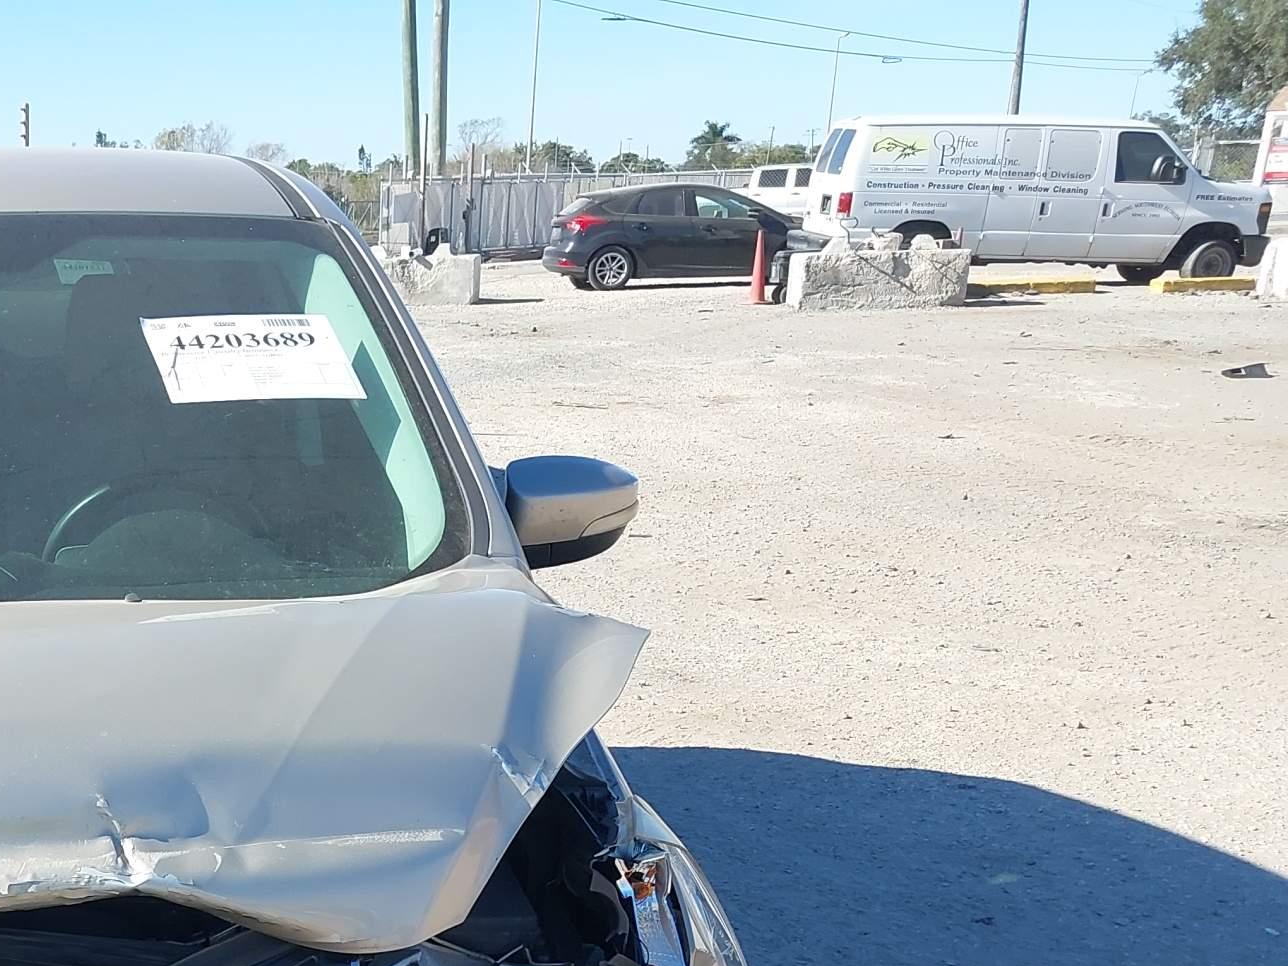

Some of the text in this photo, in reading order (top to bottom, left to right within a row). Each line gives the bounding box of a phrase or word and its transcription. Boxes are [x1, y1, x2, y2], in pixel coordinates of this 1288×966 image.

[934, 130, 979, 151] Office
[938, 144, 1021, 167] Professionals Inc.
[938, 167, 1092, 180] Property Maintenance Division
[866, 180, 1089, 195] Construction Pressure Cleaning Window Cleaning
[1217, 194, 1253, 202] Estimates
[170, 331, 316, 351] 44203689
